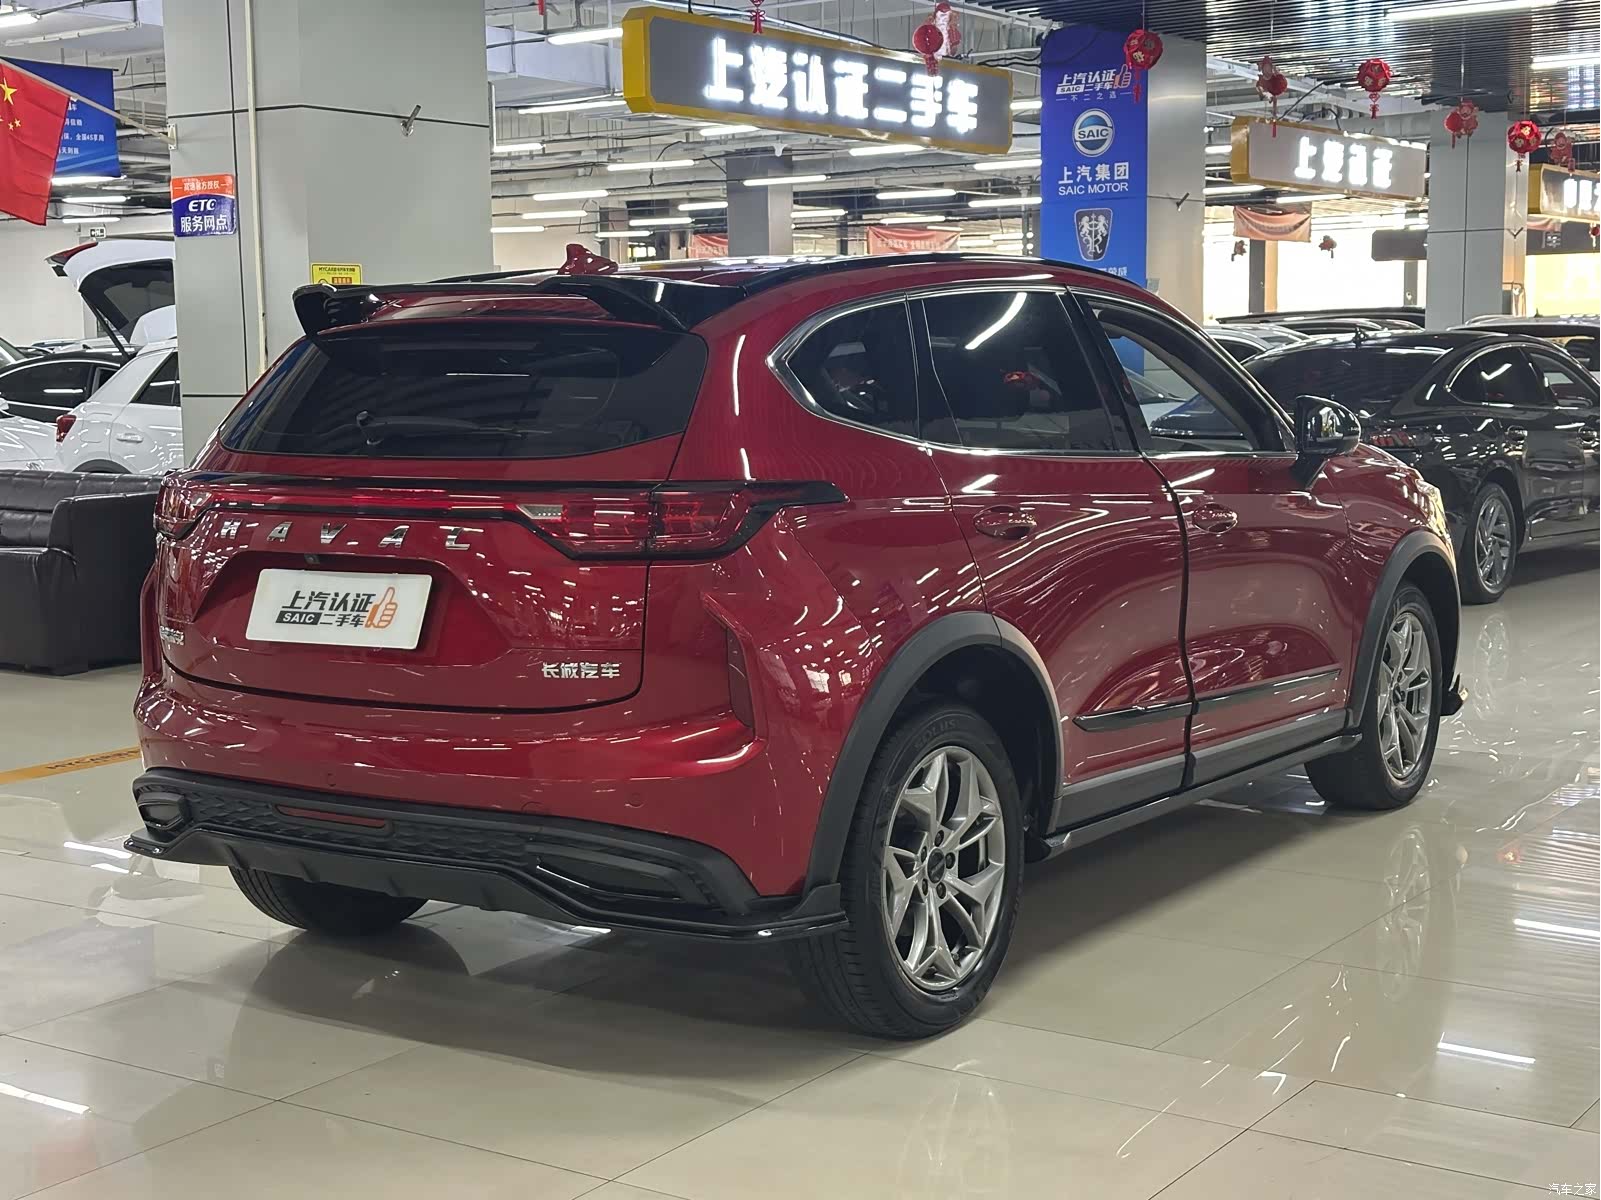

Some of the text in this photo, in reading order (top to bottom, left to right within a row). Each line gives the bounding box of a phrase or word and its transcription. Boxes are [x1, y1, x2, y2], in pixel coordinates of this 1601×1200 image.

[703, 37, 979, 134] 上汽认证二手车
[1057, 69, 1117, 86] 上汽认证
[1084, 82, 1114, 92] 二手车
[1070, 91, 1117, 102] 不二之选
[1078, 128, 1110, 140] SAIC
[1058, 161, 1129, 184] 上汽集团
[1058, 182, 1129, 196] SAIC MOTOR
[188, 198, 217, 212] ETC
[180, 214, 228, 233] 服务网点
[219, 518, 471, 551] HAVAL
[281, 590, 377, 613] 上汽认证
[282, 612, 367, 628] SAIC 二手车
[541, 662, 621, 679] 长城汽车
